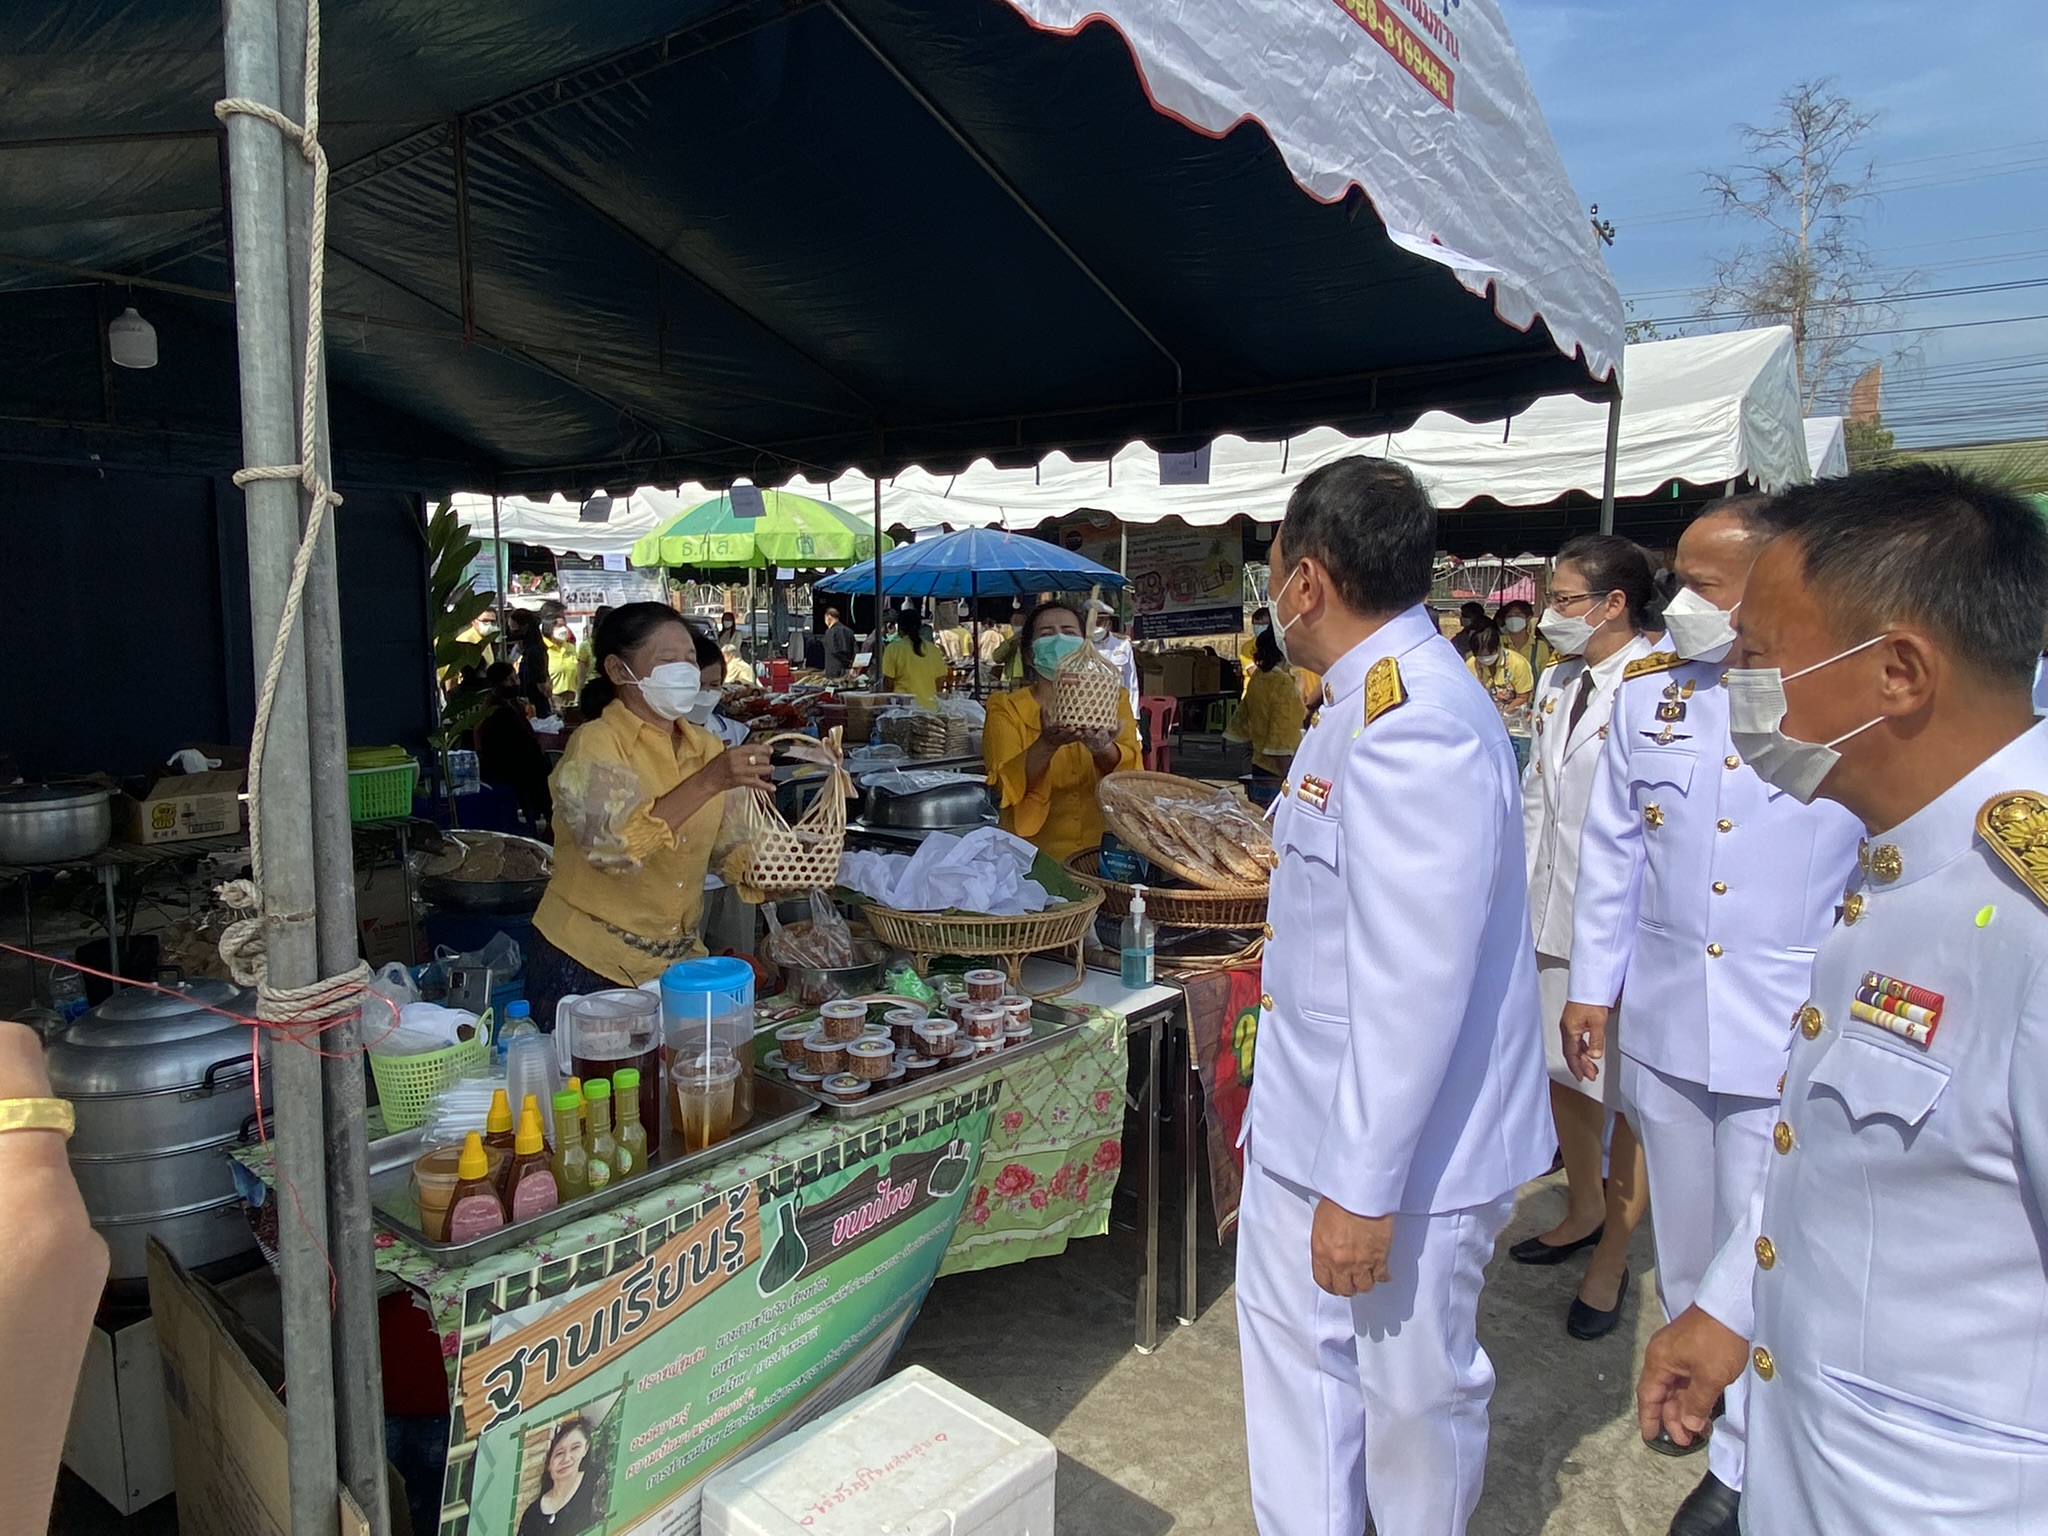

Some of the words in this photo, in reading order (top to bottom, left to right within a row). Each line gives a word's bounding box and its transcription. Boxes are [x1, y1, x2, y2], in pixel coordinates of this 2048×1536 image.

[832, 1177, 917, 1246] ขนมไทย
[482, 1183, 751, 1434] ฐานเรียนรู้
[629, 1402, 692, 1452] องค์ความรู้
